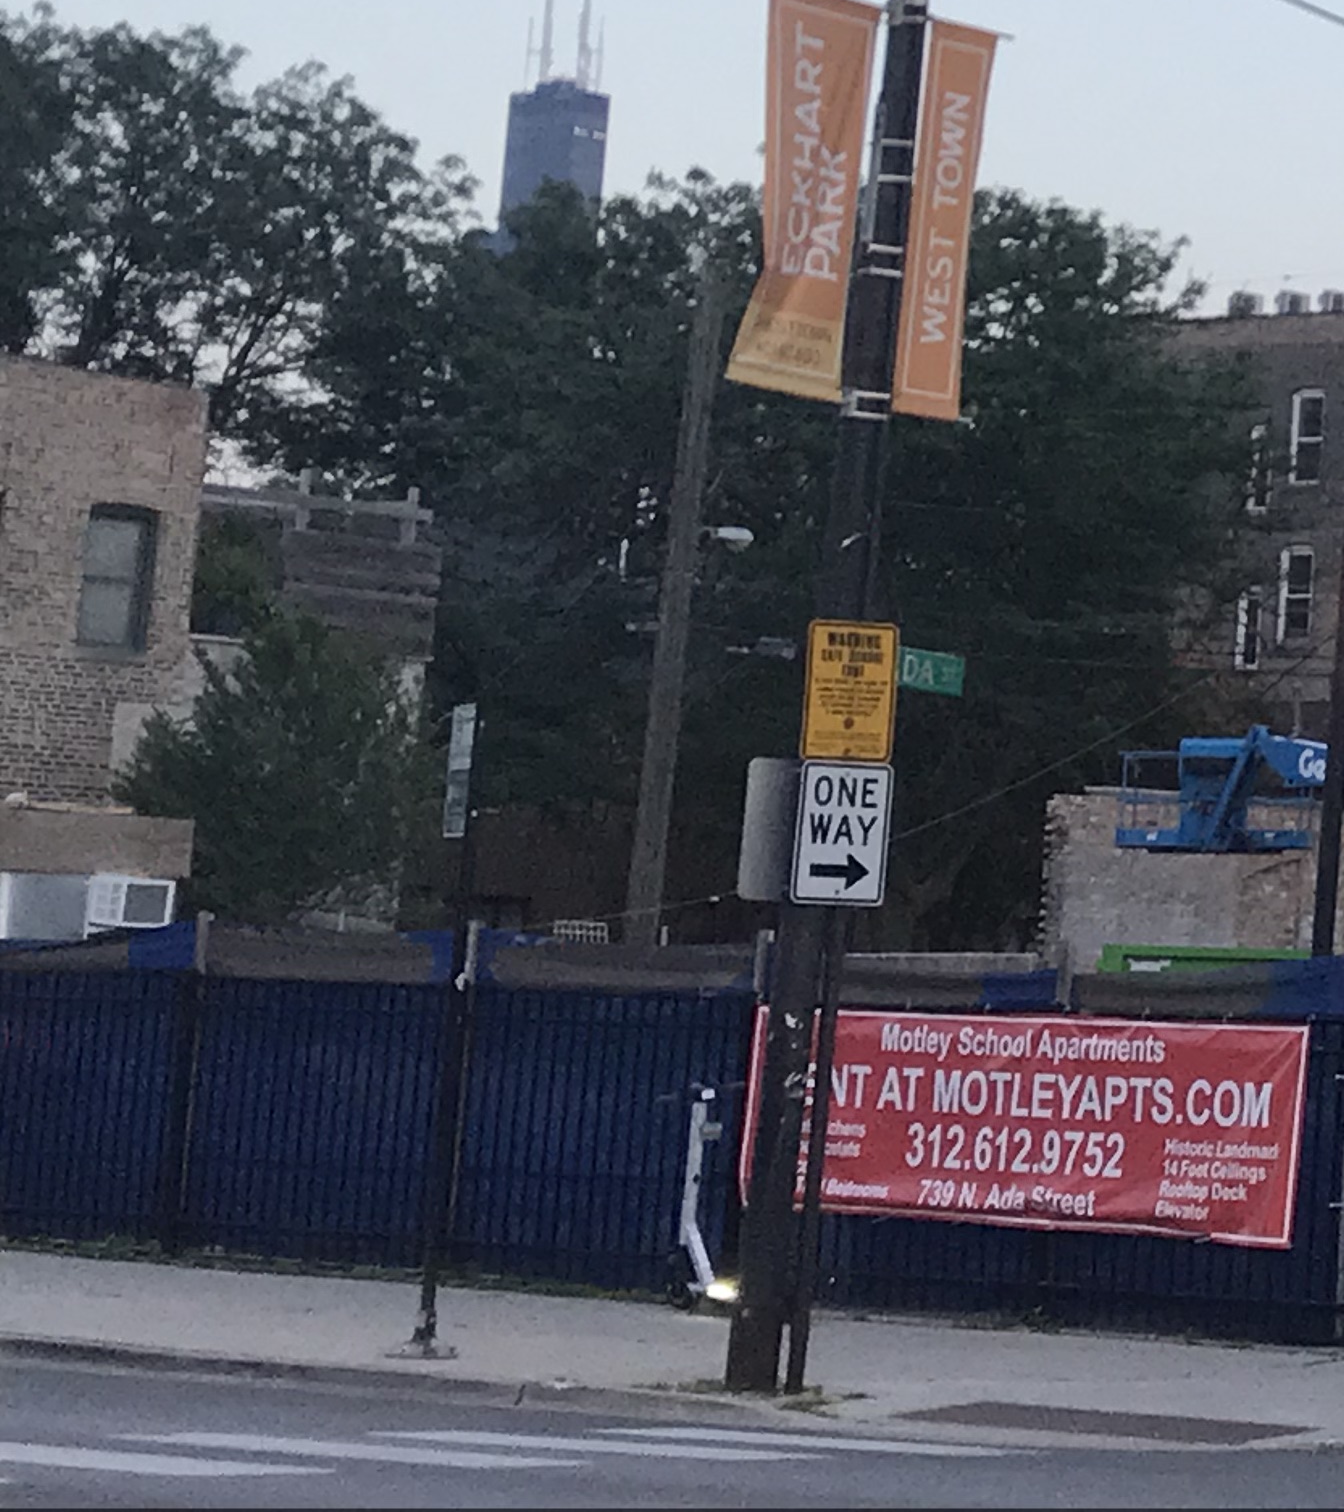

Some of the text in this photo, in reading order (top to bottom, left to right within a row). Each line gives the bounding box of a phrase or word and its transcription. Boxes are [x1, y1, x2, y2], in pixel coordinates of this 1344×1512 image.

[781, 20, 825, 276] ECKHART
[804, 148, 848, 283] PARK
[920, 92, 972, 345] WEST TOWN
[901, 654, 934, 686] DA
[814, 774, 879, 809] ONE
[809, 813, 877, 846] WAY
[881, 1022, 1166, 1065] Motley School Apartments
[876, 1066, 924, 1112] AT
[932, 1069, 1273, 1128] MOTLEYAPTS.COM
[905, 1122, 1125, 1178] 312.612.9752
[1164, 1138, 1214, 1157] Historic
[1162, 1159, 1267, 1184] 14 Foot Ceilings
[916, 1179, 1096, 1216] 739 N. Ada Street
[1159, 1180, 1248, 1202] Rooftop Deck
[1155, 1200, 1210, 1220] Elevator
